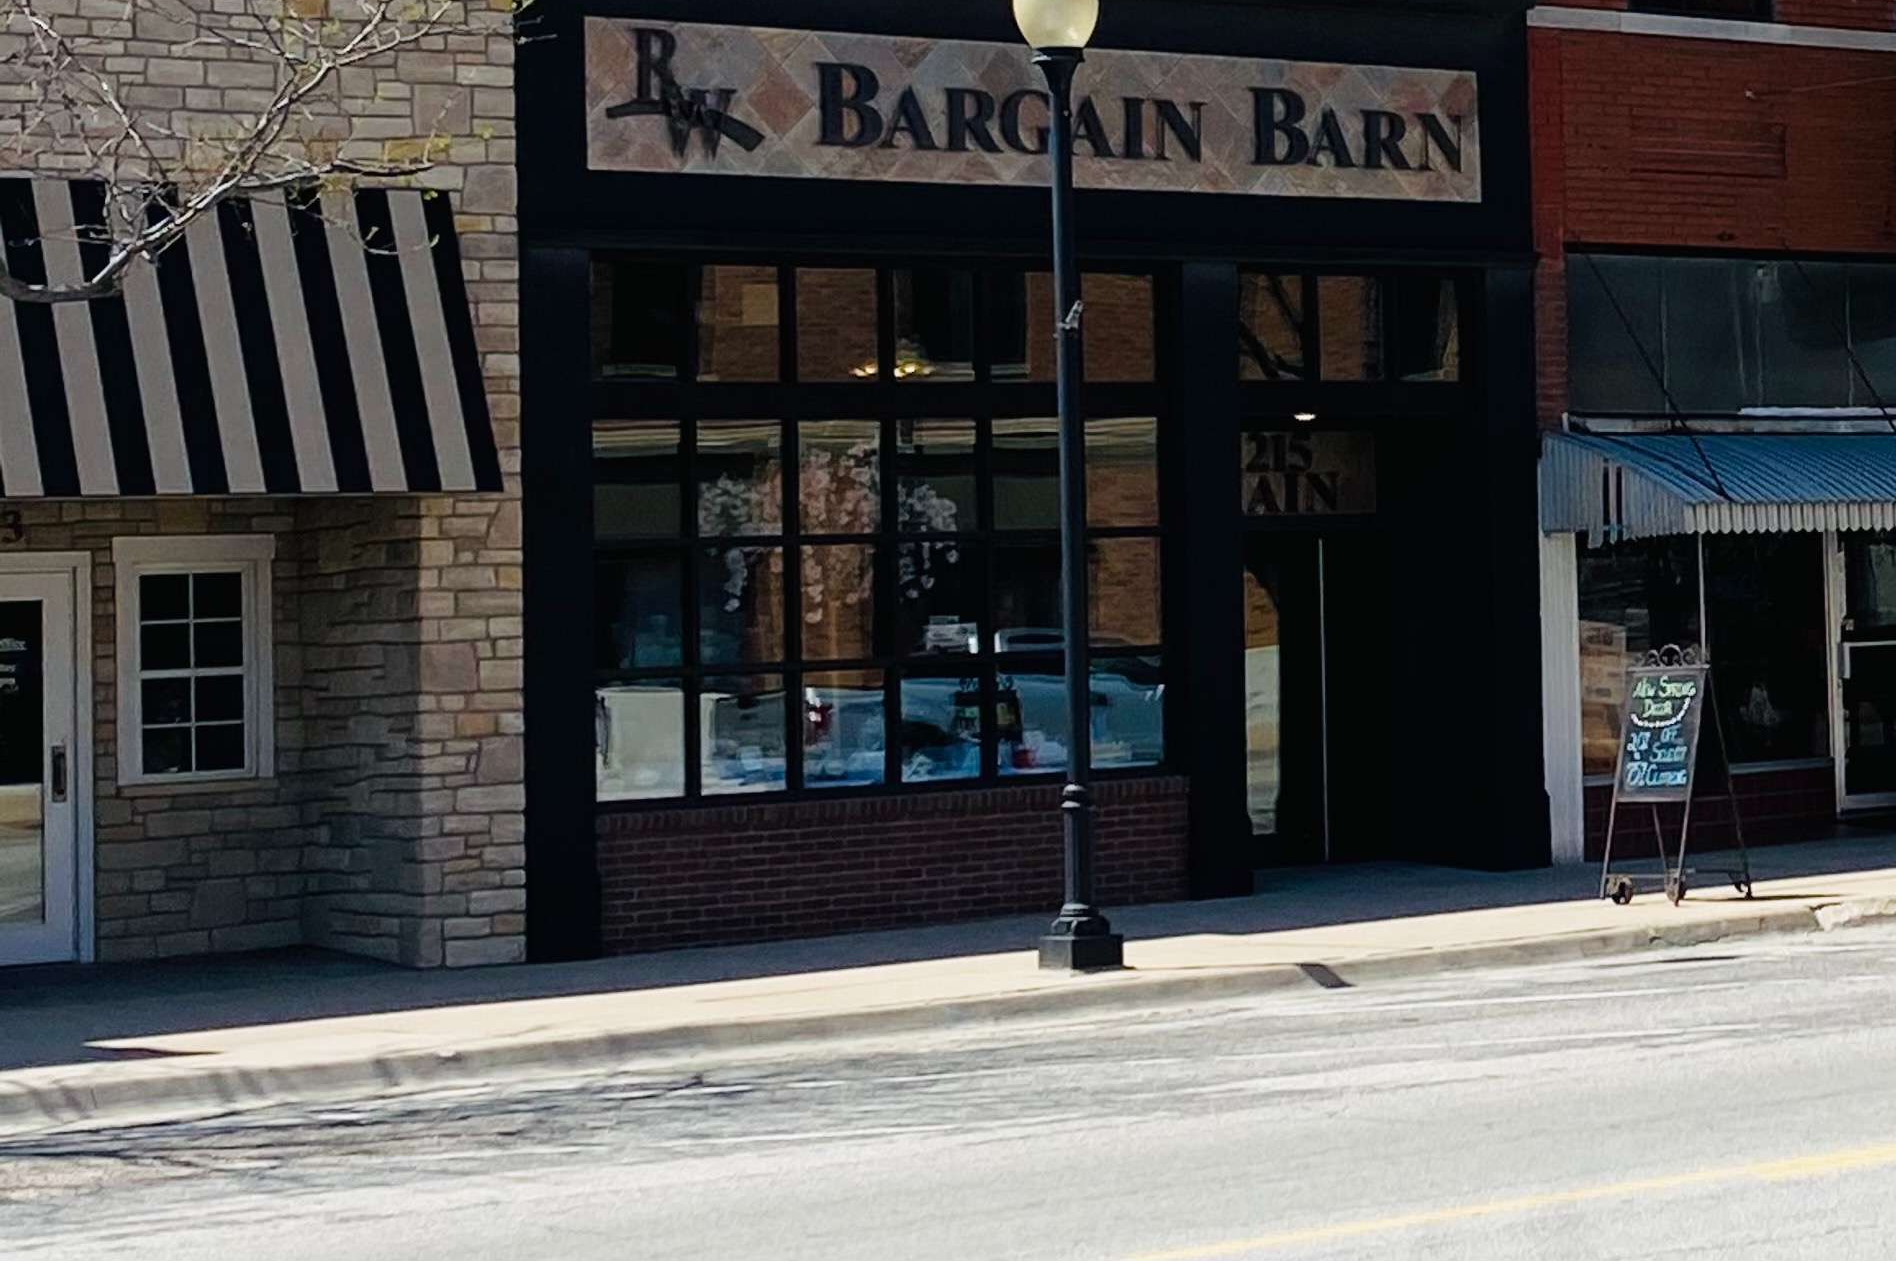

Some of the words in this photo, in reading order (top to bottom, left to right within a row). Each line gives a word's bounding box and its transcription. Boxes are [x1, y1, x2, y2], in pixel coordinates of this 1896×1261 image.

[814, 62, 1207, 163] BARGAIN
[1247, 87, 1463, 172] BARN
[1247, 472, 1341, 514] AIN
